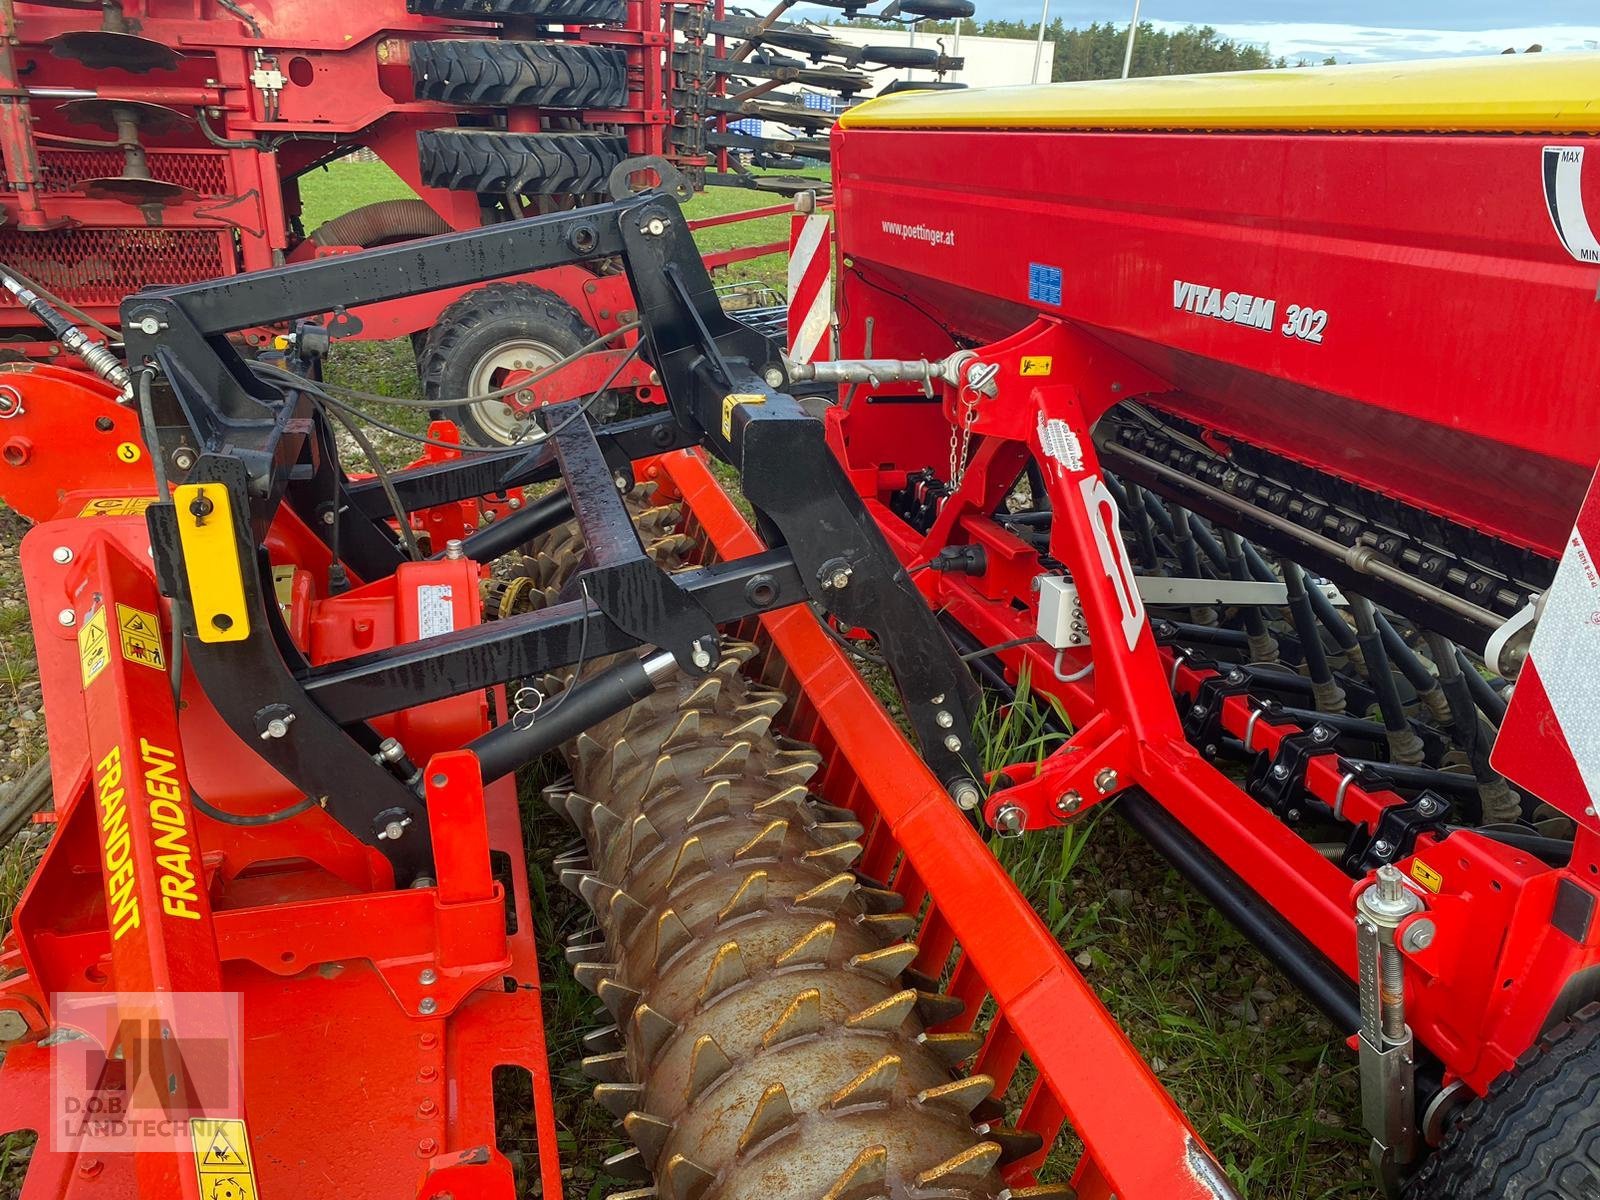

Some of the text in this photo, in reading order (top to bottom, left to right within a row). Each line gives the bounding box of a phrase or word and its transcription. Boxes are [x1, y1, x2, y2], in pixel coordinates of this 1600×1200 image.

[1561, 151, 1581, 163] MAX
[882, 221, 955, 246] www.poettinger.at
[1580, 248, 1599, 260] MIN
[1173, 280, 1328, 344] VITASEM 302
[97, 745, 140, 940] FRANDENT
[139, 737, 201, 919] FRANDENT
